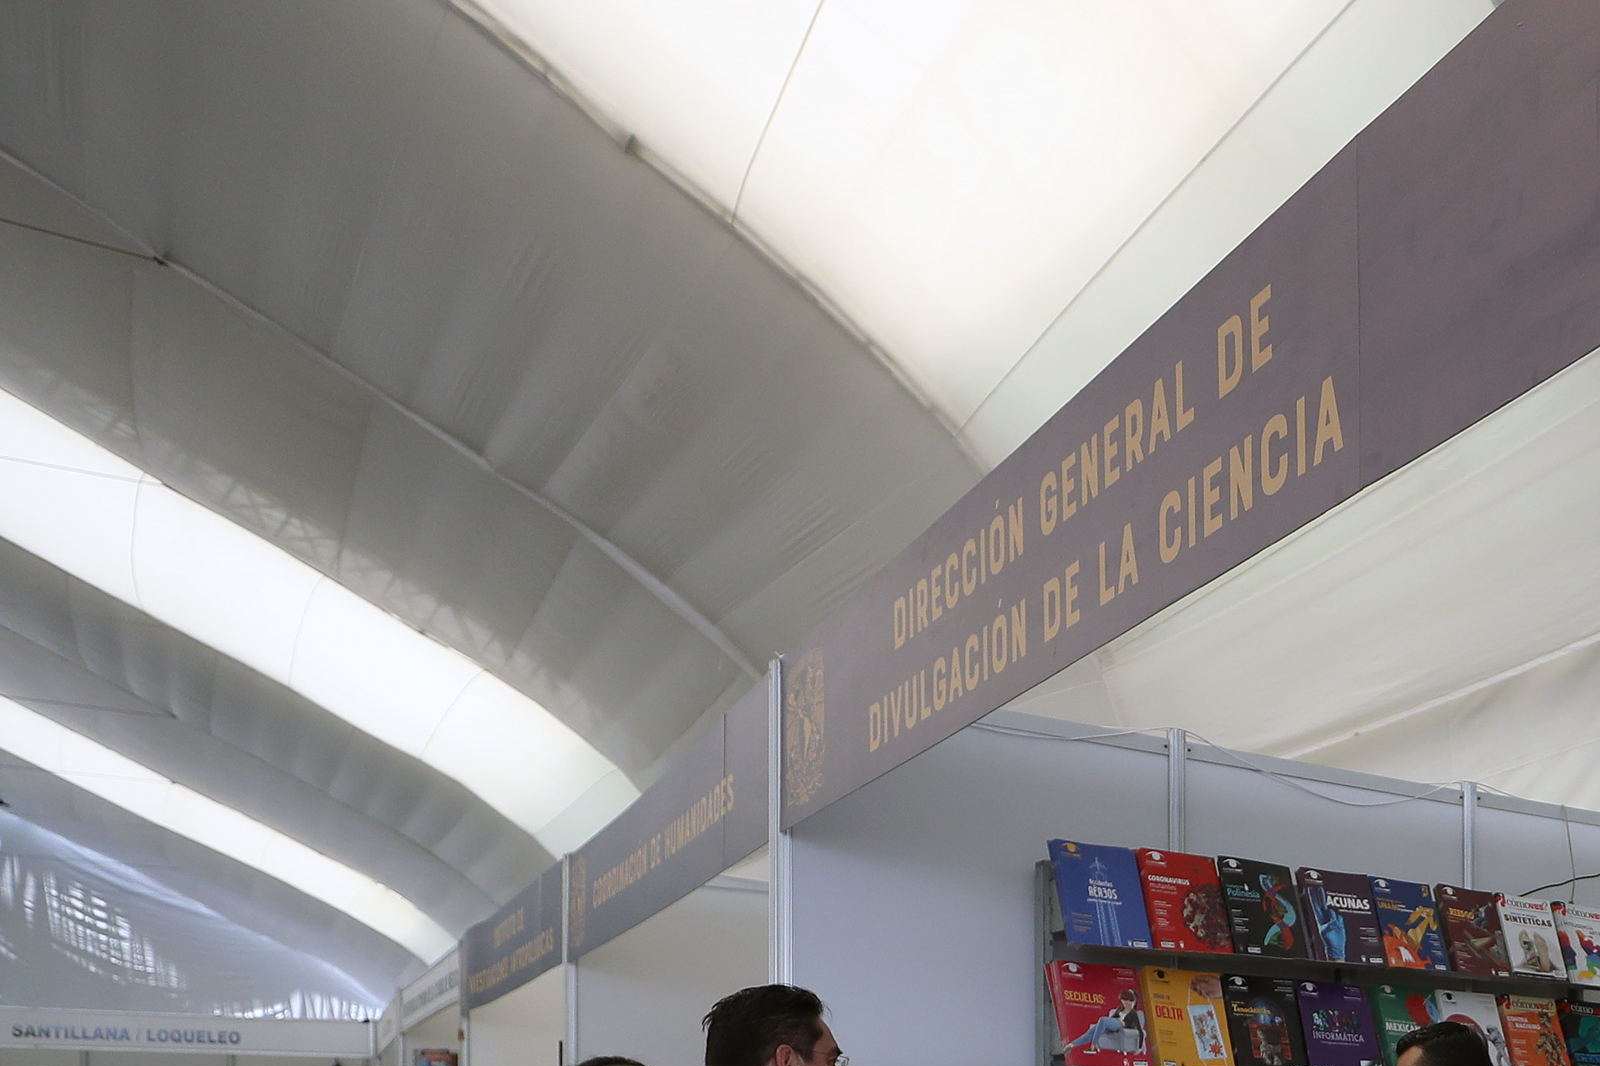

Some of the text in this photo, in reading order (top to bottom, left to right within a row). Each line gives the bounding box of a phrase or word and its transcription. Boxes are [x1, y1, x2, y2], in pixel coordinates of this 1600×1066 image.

[891, 283, 1276, 651] DIRECCIÓN GENERAL DE
[868, 375, 1345, 754] DIVULGACIÓN DE LA CIENCIA
[650, 832, 661, 866] DE
[664, 772, 735, 859] HUMANIDADES
[11, 1023, 131, 1041] SANTILLANA
[146, 1028, 241, 1045] LOQUELEO
[1155, 1005, 1183, 1021] DELTA
[1312, 1029, 1365, 1043] INFORMÁTICA
